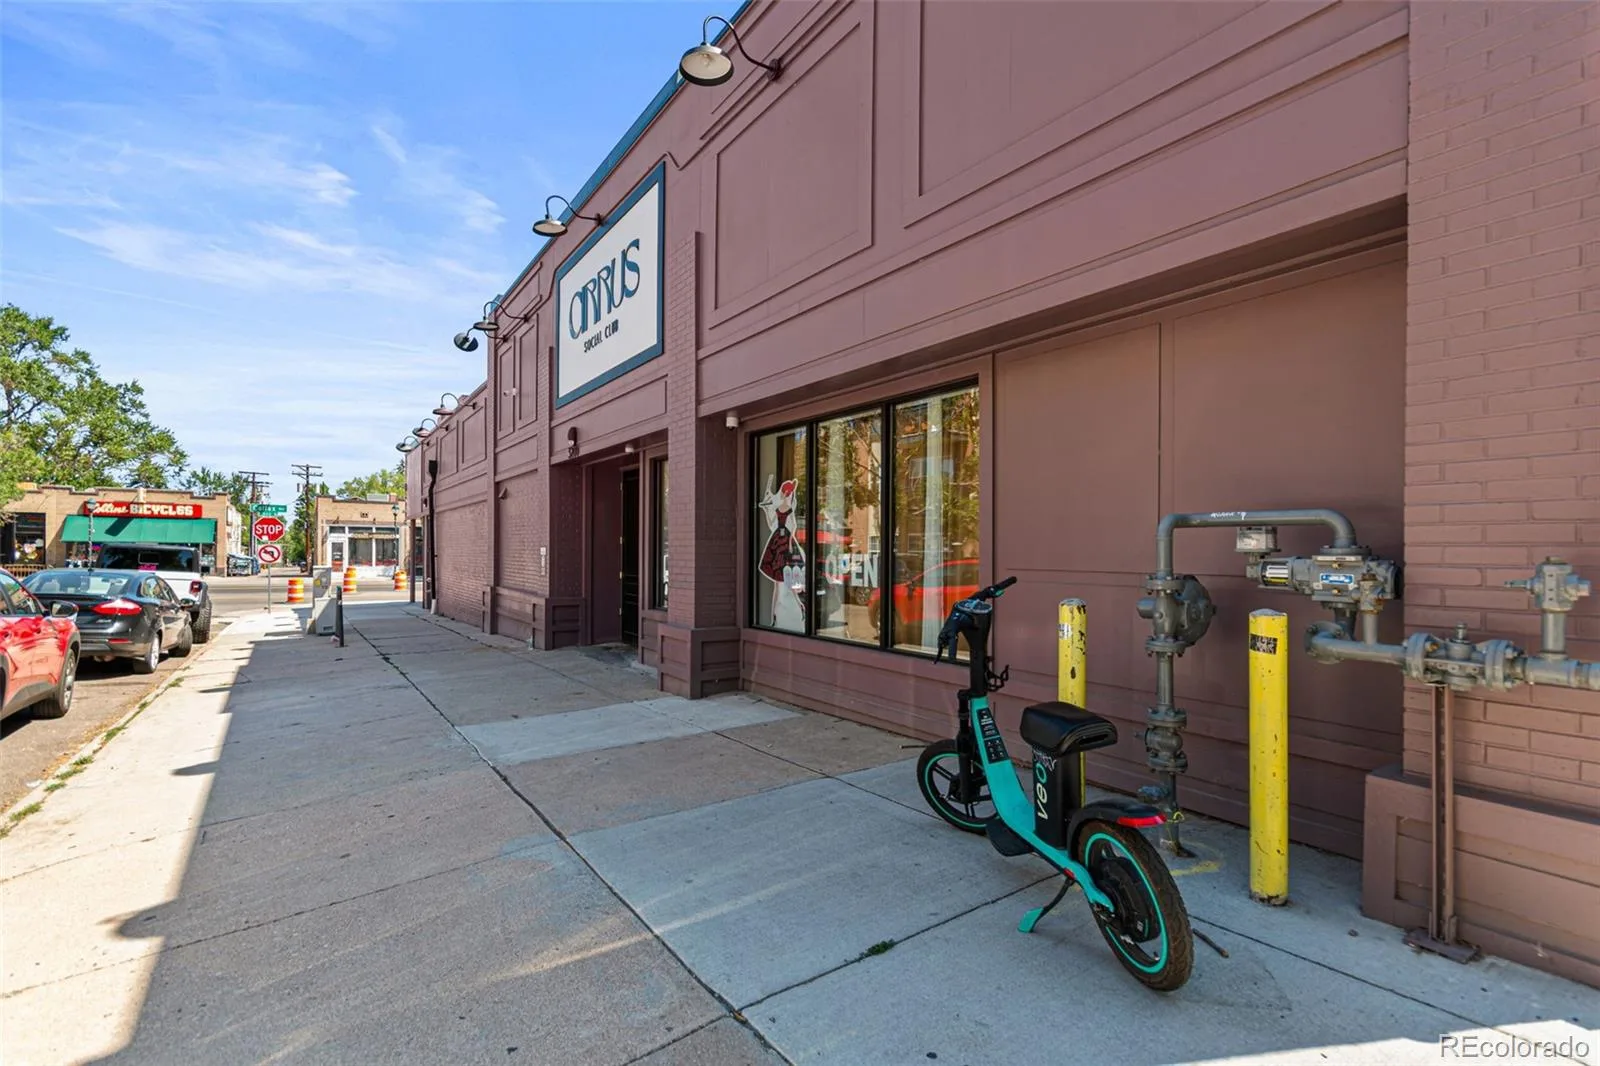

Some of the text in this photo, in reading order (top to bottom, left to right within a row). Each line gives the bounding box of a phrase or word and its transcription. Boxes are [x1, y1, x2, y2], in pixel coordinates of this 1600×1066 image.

[569, 238, 640, 339] CIRRUS
[583, 330, 603, 353] SOCIAL
[255, 524, 283, 535] STOP
[825, 553, 878, 587] OPEN
[1035, 762, 1048, 820] veo
